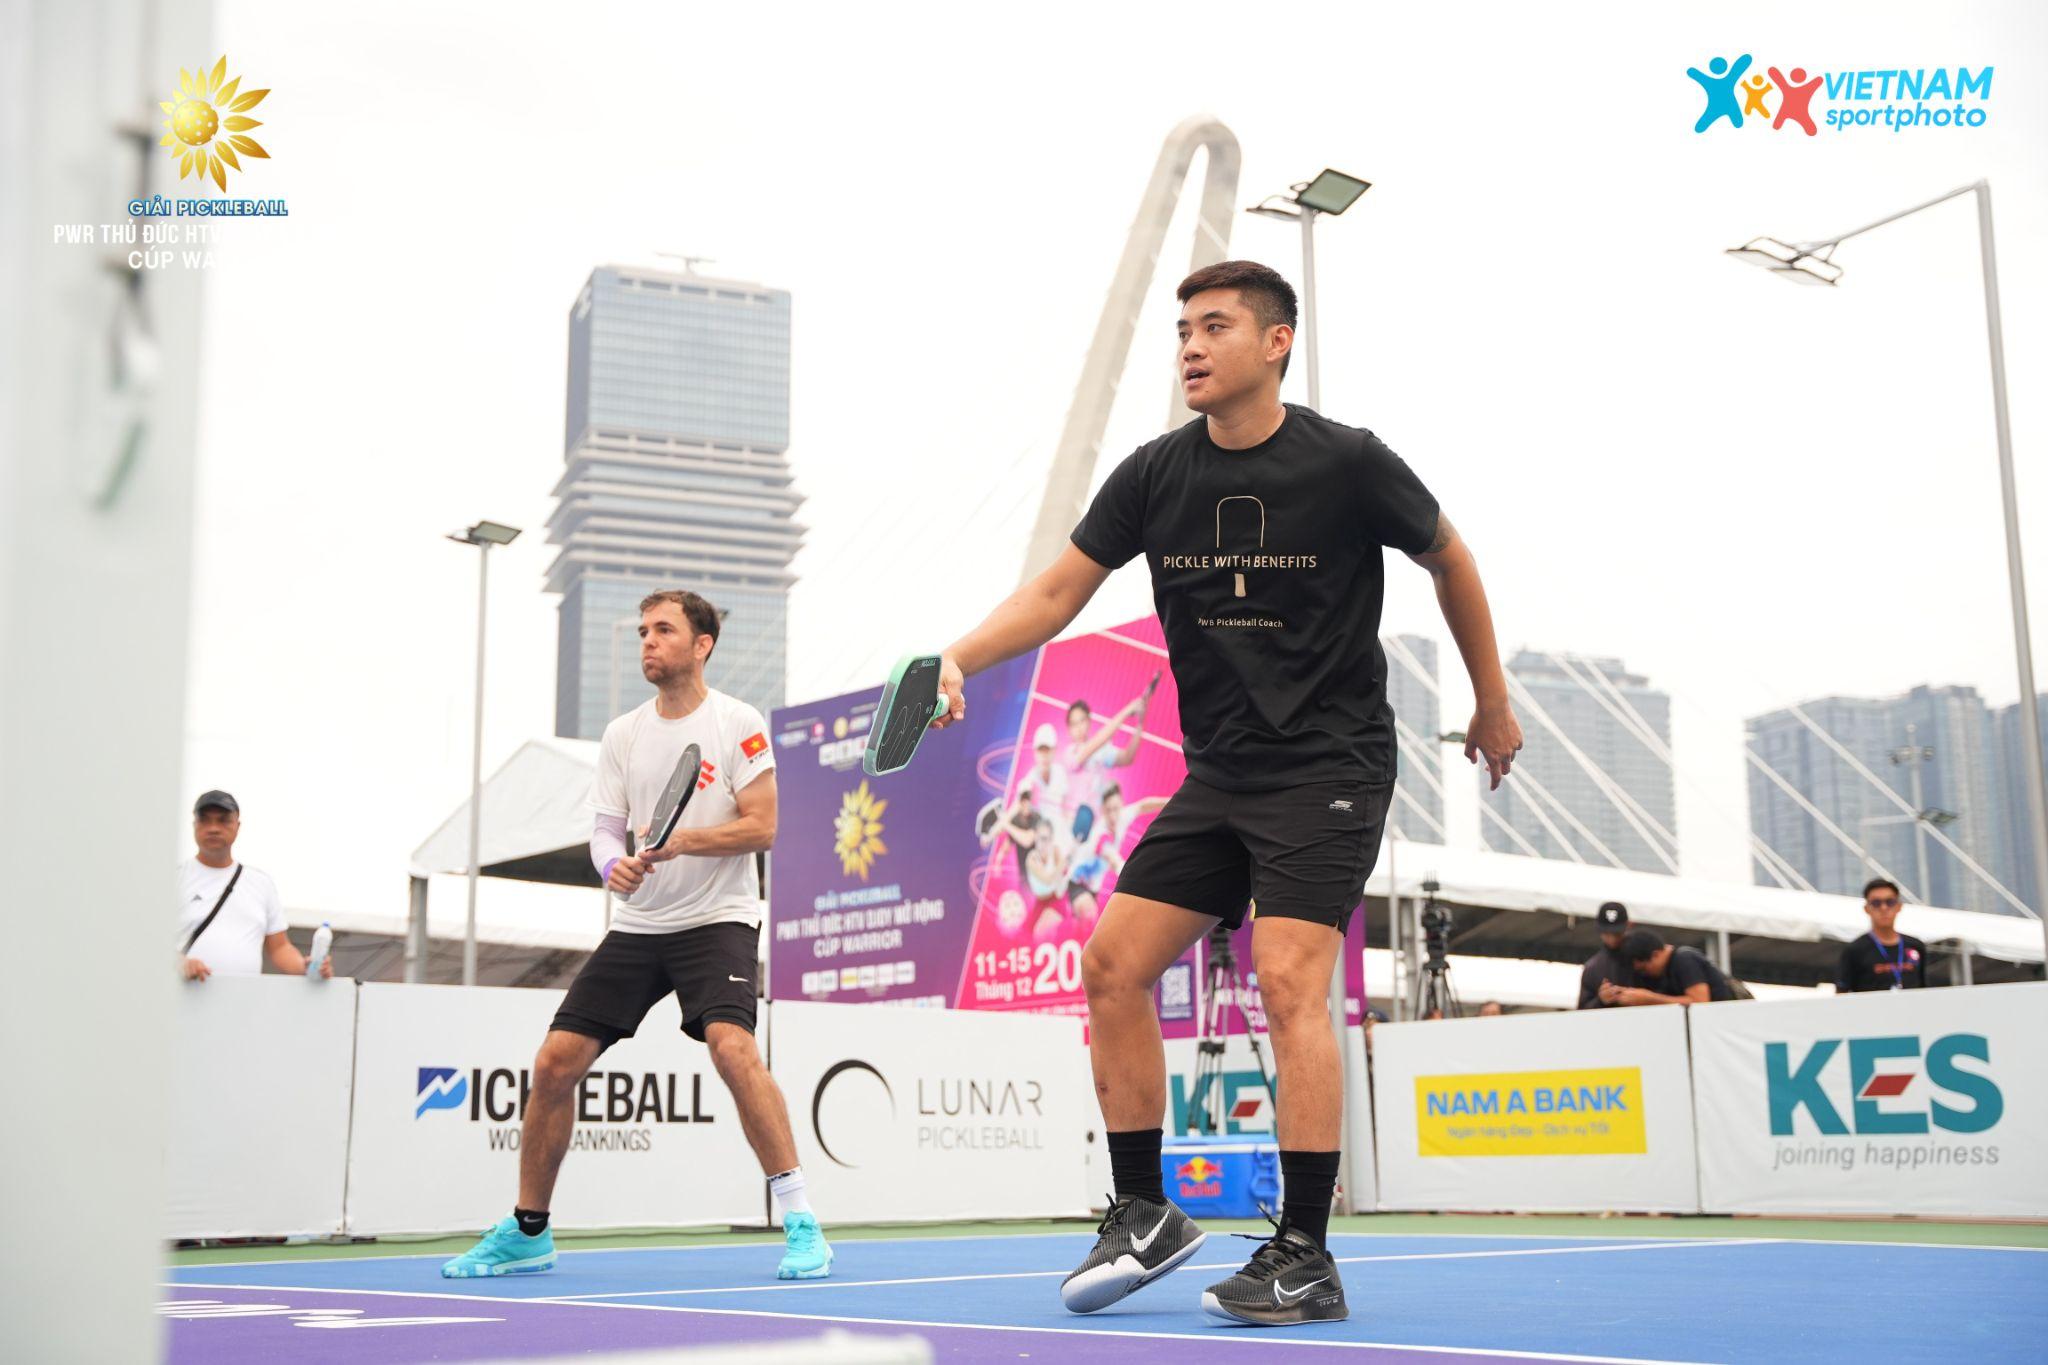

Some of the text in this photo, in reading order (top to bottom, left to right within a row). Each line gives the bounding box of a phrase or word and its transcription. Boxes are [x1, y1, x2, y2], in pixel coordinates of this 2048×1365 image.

[1163, 555, 1317, 569] PICKLE WITH BENEFITS
[1216, 618, 1257, 627] Pickleball
[1258, 618, 1283, 628] Coach
[842, 929, 903, 954] WARRIOR
[974, 939, 1082, 994] 11-15 20
[1016, 976, 1032, 996] 12
[918, 1078, 1043, 1116] LUNAR
[1764, 1033, 2004, 1136] KES
[1427, 1085, 1628, 1116] NAM A BANK
[569, 1128, 651, 1151] ANKINGS
[918, 1126, 1044, 1150] PICKLEBALL
[1773, 1141, 2000, 1171] joining happiness
